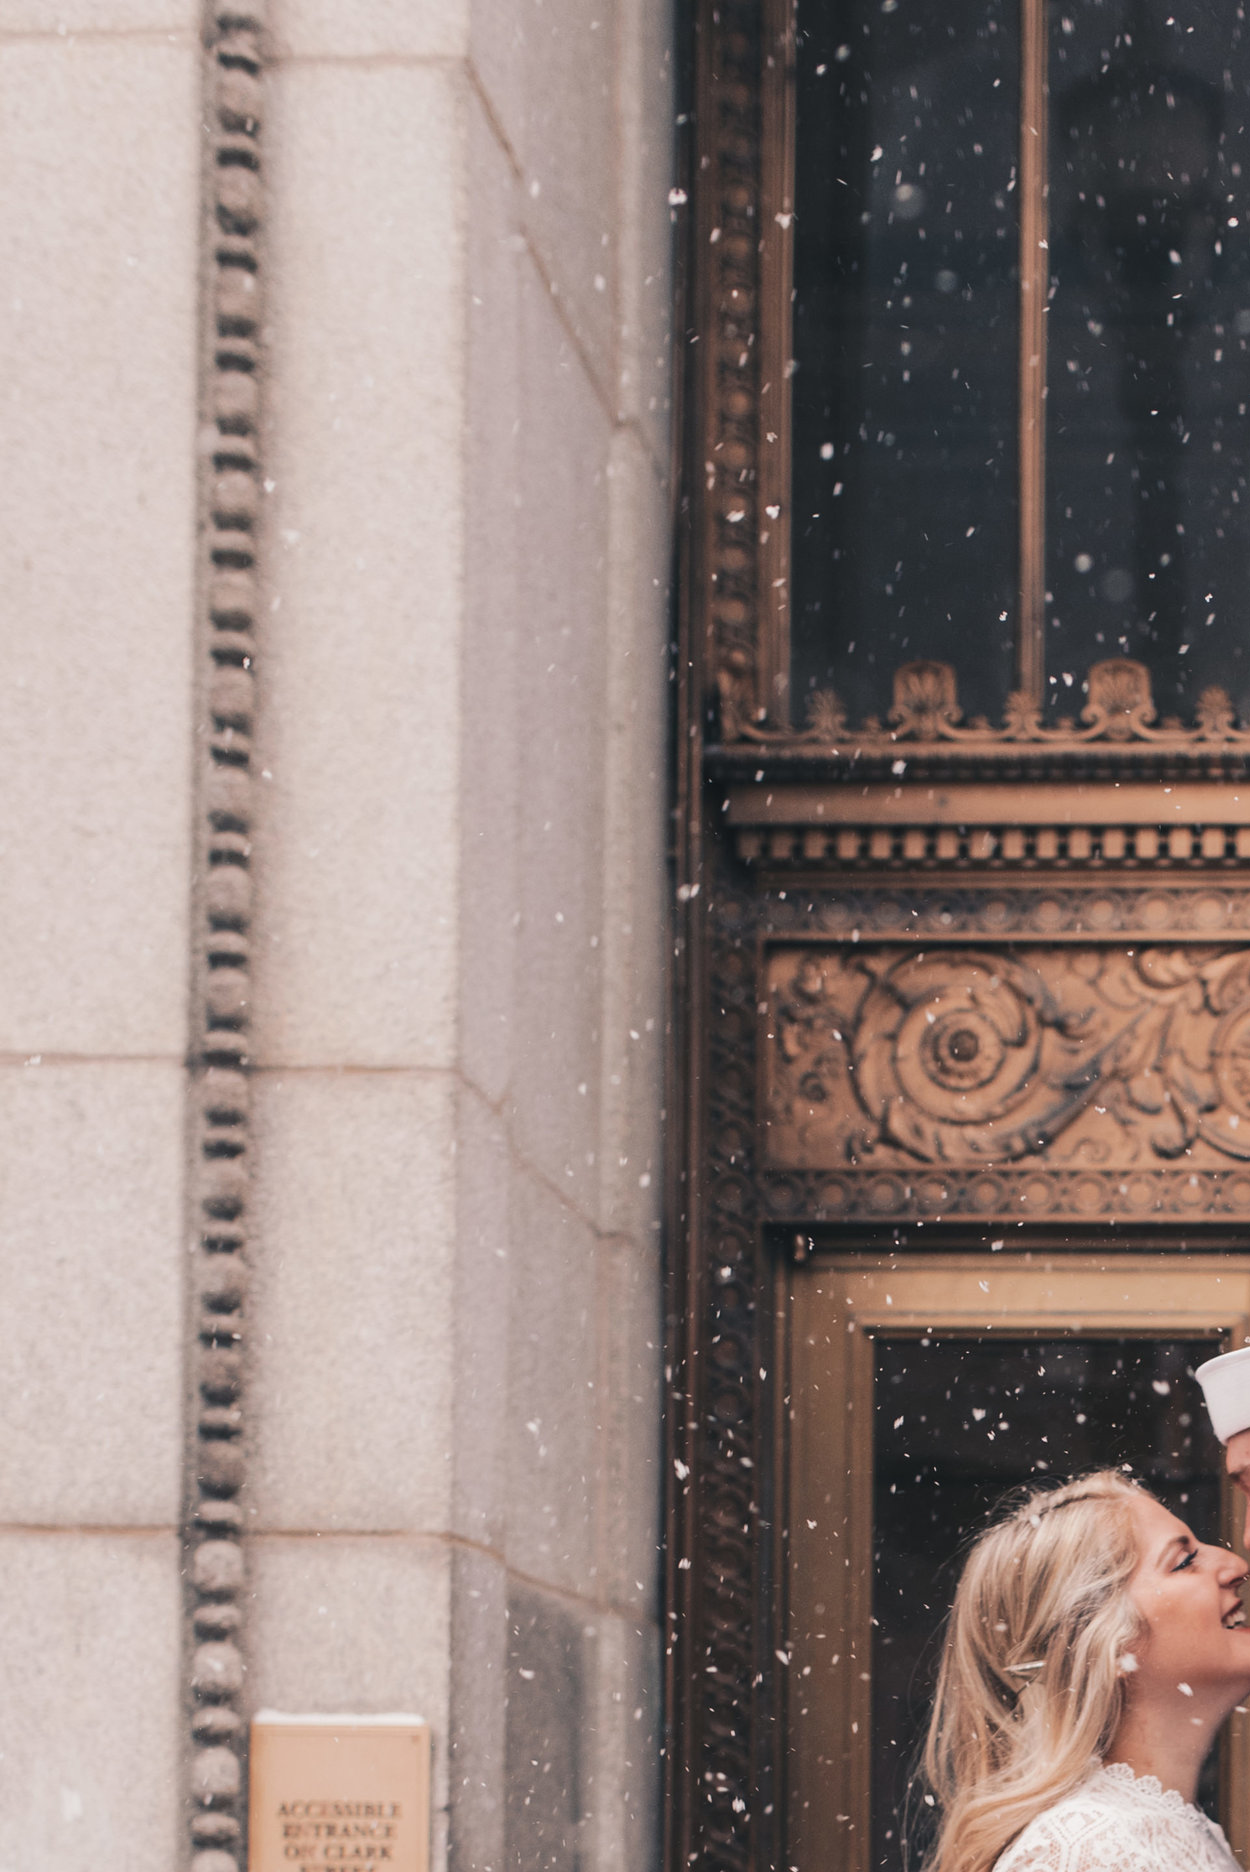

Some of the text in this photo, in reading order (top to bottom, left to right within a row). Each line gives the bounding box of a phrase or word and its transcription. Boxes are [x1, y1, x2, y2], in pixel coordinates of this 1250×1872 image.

[278, 1801, 402, 1817] ACCESSIBLE
[283, 1824, 397, 1839] ENTRANCE
[284, 1845, 392, 1860] ON CLARK
